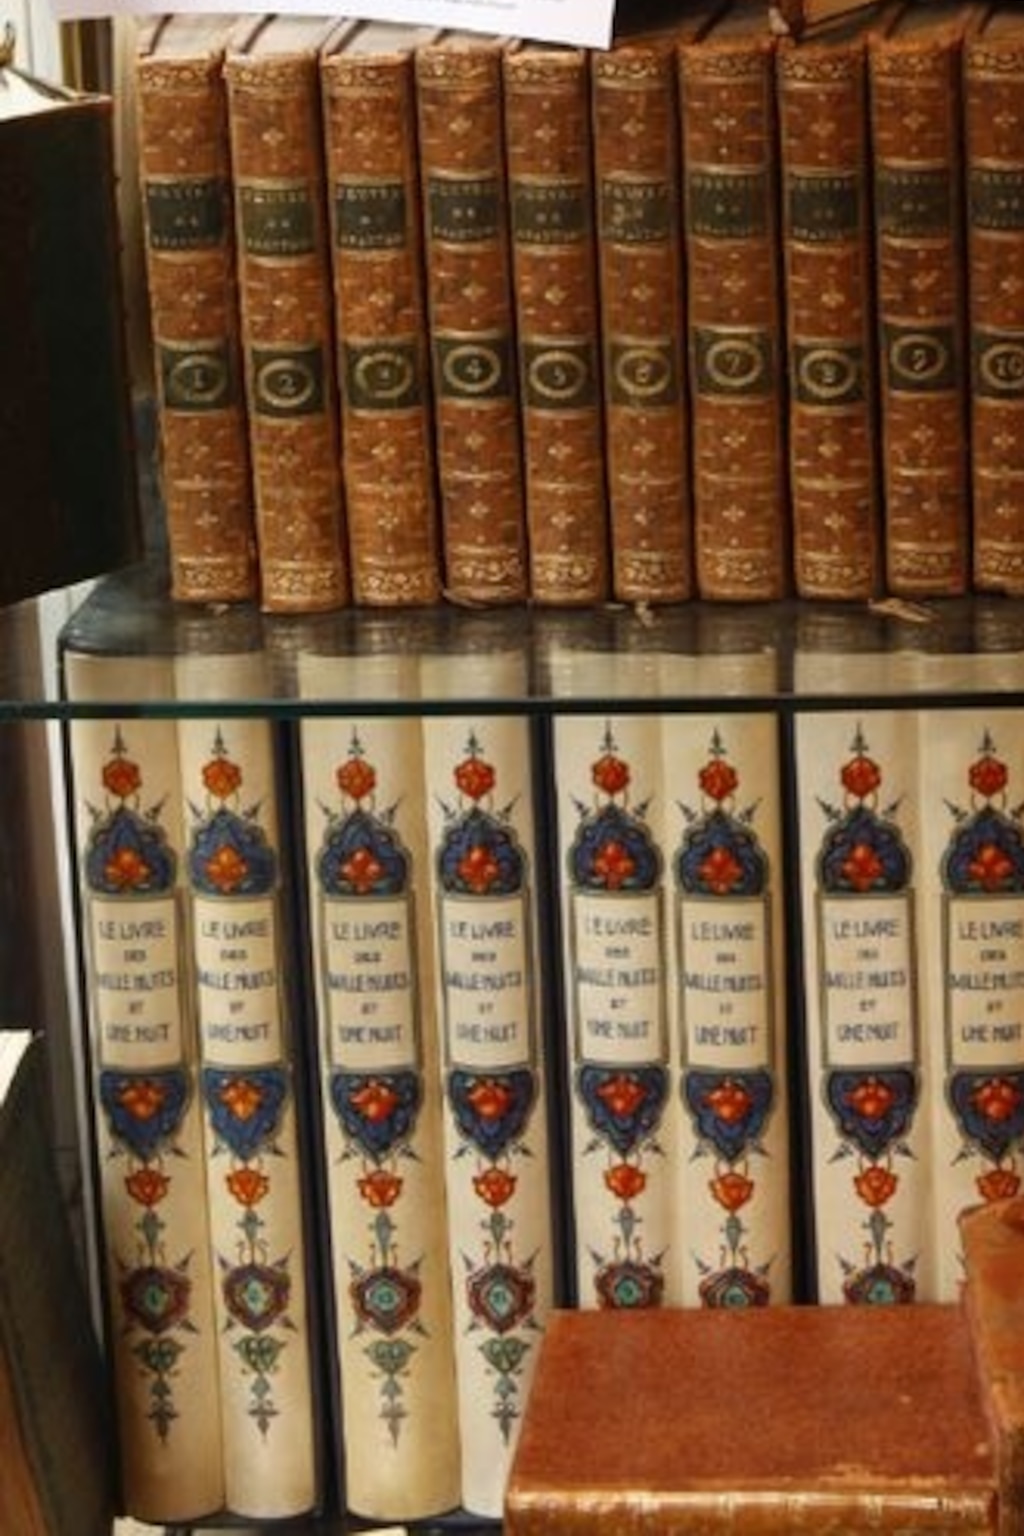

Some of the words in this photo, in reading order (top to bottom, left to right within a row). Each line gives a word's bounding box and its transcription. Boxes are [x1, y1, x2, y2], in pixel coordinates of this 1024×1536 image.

[100, 921, 115, 939] LE
[121, 921, 166, 940] LIVRE
[202, 921, 219, 940] LE
[224, 919, 269, 939] LIVRE
[332, 922, 350, 940] LE
[354, 921, 402, 940] LIVRE
[450, 921, 468, 938] LE
[471, 921, 516, 939] LIVRE
[586, 917, 602, 935] LE
[605, 917, 652, 936] LIVRE
[692, 922, 711, 940] LE
[713, 922, 754, 940] LIVRE
[833, 920, 850, 938] LE
[856, 919, 900, 937] LIVRE
[959, 922, 977, 940] LE
[981, 921, 1024, 940] LIVRE
